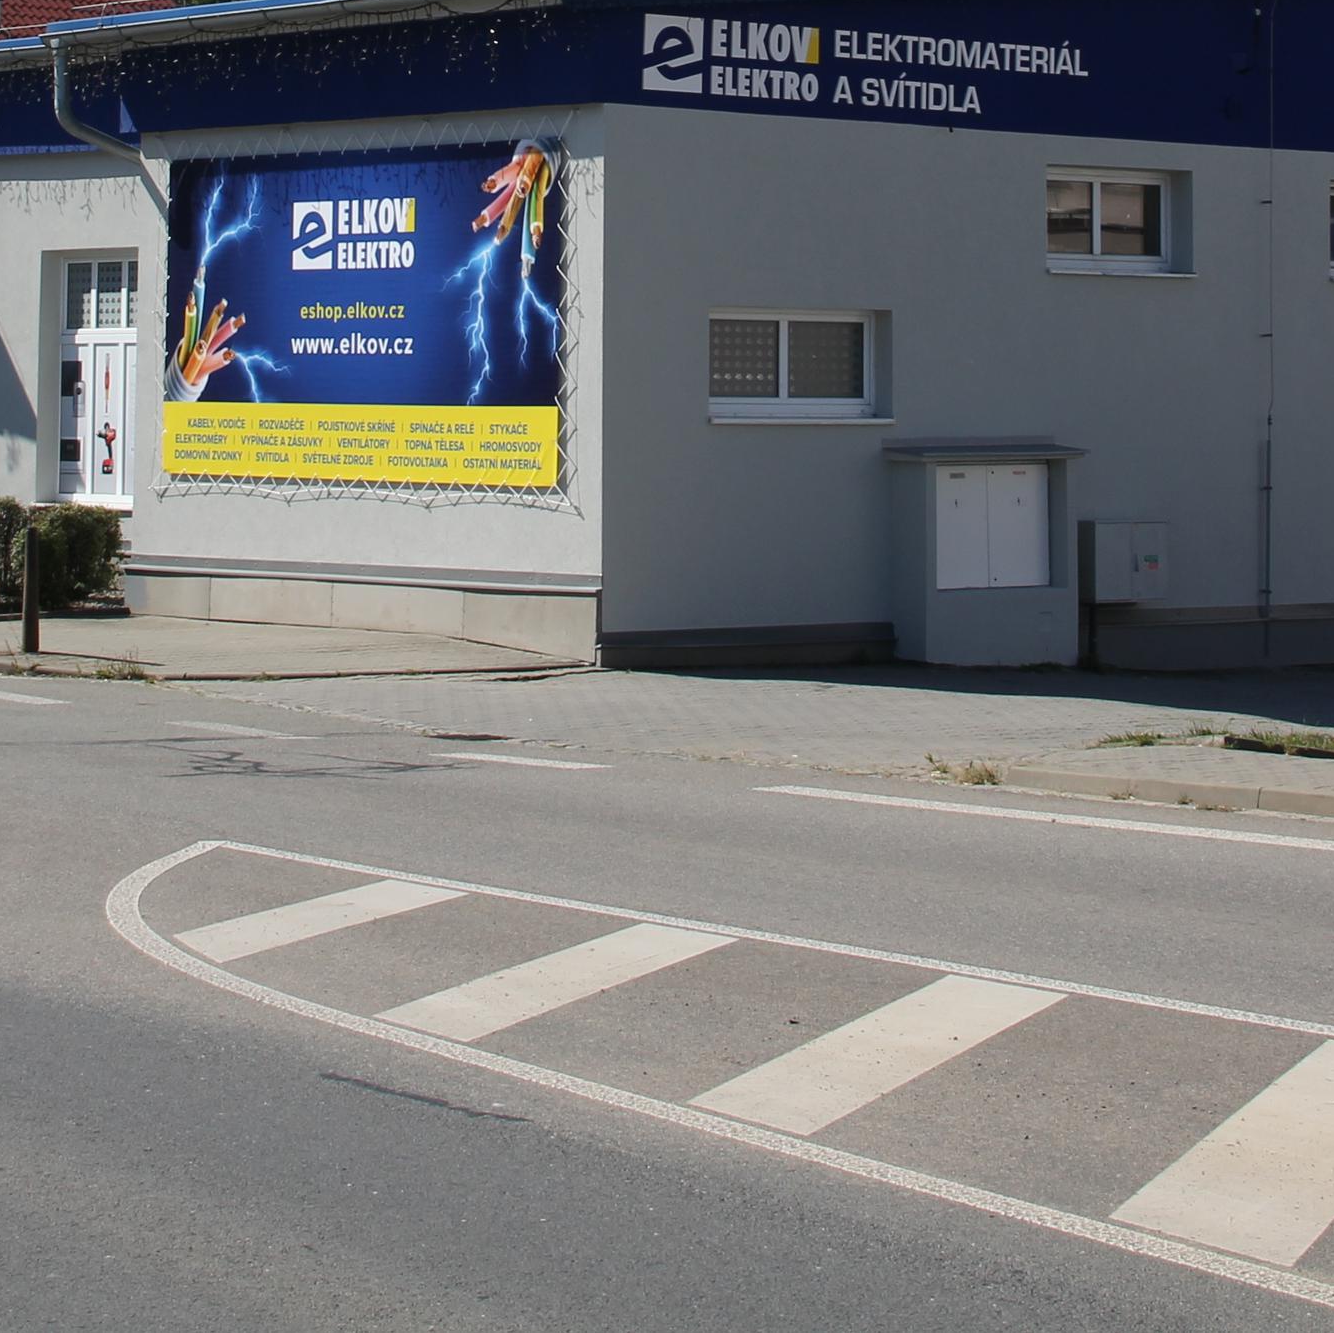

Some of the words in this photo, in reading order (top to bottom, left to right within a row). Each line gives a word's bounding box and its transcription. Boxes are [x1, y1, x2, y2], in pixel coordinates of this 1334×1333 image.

[710, 18, 816, 64] ELKOV
[834, 29, 1089, 77] ELEKTROMATERIÁL
[710, 65, 819, 102] ELEKTRO
[832, 75, 854, 105] A
[861, 71, 982, 114] SVÍTIDLA
[338, 198, 412, 235] ELKOV
[337, 240, 415, 270] ELEKTRO
[300, 301, 405, 323] eshop.elkov.cz
[291, 332, 414, 355] www.elkov.cz
[217, 416, 246, 429] VODIČE
[259, 417, 305, 431] ROZVADĚČE
[317, 419, 366, 432] POJISTKOVÉ
[410, 421, 444, 435] SPÍNAČE
[447, 424, 453, 434] A
[455, 422, 475, 435] RELÉ
[489, 421, 528, 435] STYKAČE
[175, 431, 228, 444] ELEKTROMĚRY
[241, 433, 279, 446] VYPÍNAČE
[280, 435, 286, 446] A
[287, 434, 323, 447] ZÁSUVKY
[337, 436, 391, 449] VENTILÁTORY
[405, 437, 432, 451] TOPNÁ
[435, 438, 465, 452] TĚLESA
[174, 447, 210, 460] DOMOVNÍ
[212, 450, 243, 461] ZVONKY
[480, 441, 542, 453] HROMOSVODY
[255, 449, 289, 462] SVÍTIDLA
[343, 454, 374, 466] ZDROJE
[388, 455, 448, 468] FOTOVOLTAIKA
[463, 455, 498, 469] OSTATNÍ
